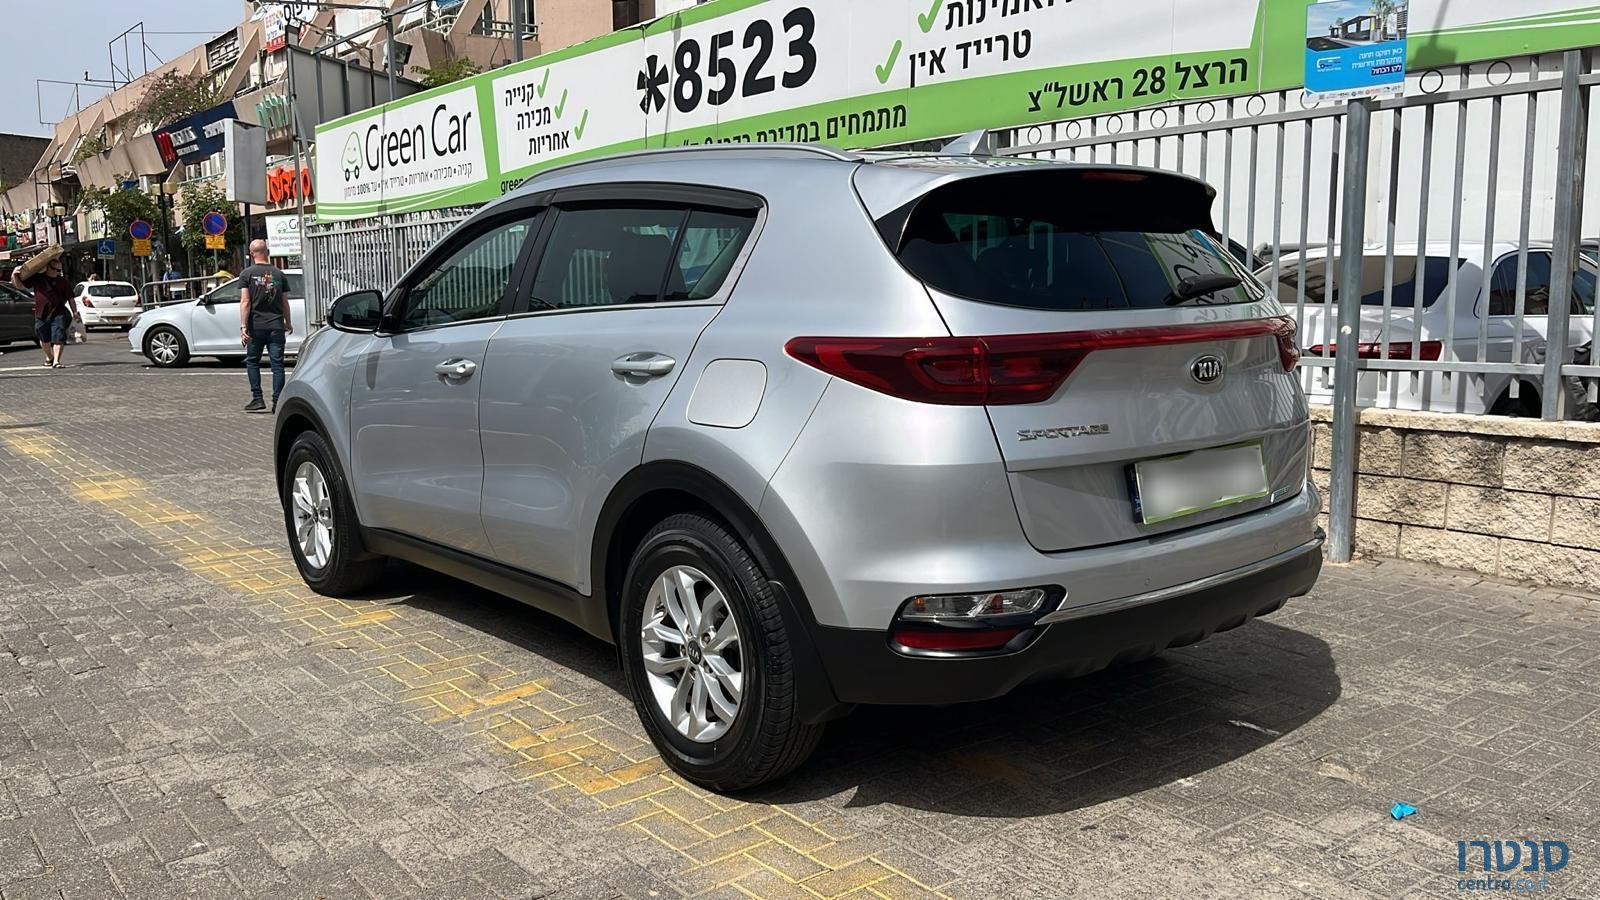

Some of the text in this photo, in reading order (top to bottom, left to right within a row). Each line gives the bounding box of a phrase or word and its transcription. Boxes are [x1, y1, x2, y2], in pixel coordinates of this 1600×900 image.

[909, 29, 1032, 89] טרייד אין
[1132, 65, 1166, 98] 28
[1174, 57, 1248, 91] הרצל
[505, 83, 534, 107] קנייה
[517, 106, 551, 131] מכירה
[826, 104, 907, 140] מתמחים
[365, 103, 472, 172] Green Car
[528, 130, 570, 156] אחריות
[408, 171, 429, 185] אחריות
[434, 166, 453, 180] מכירה
[457, 162, 473, 179] קניה
[357, 183, 370, 195] 100%
[1197, 361, 1220, 379] KIA
